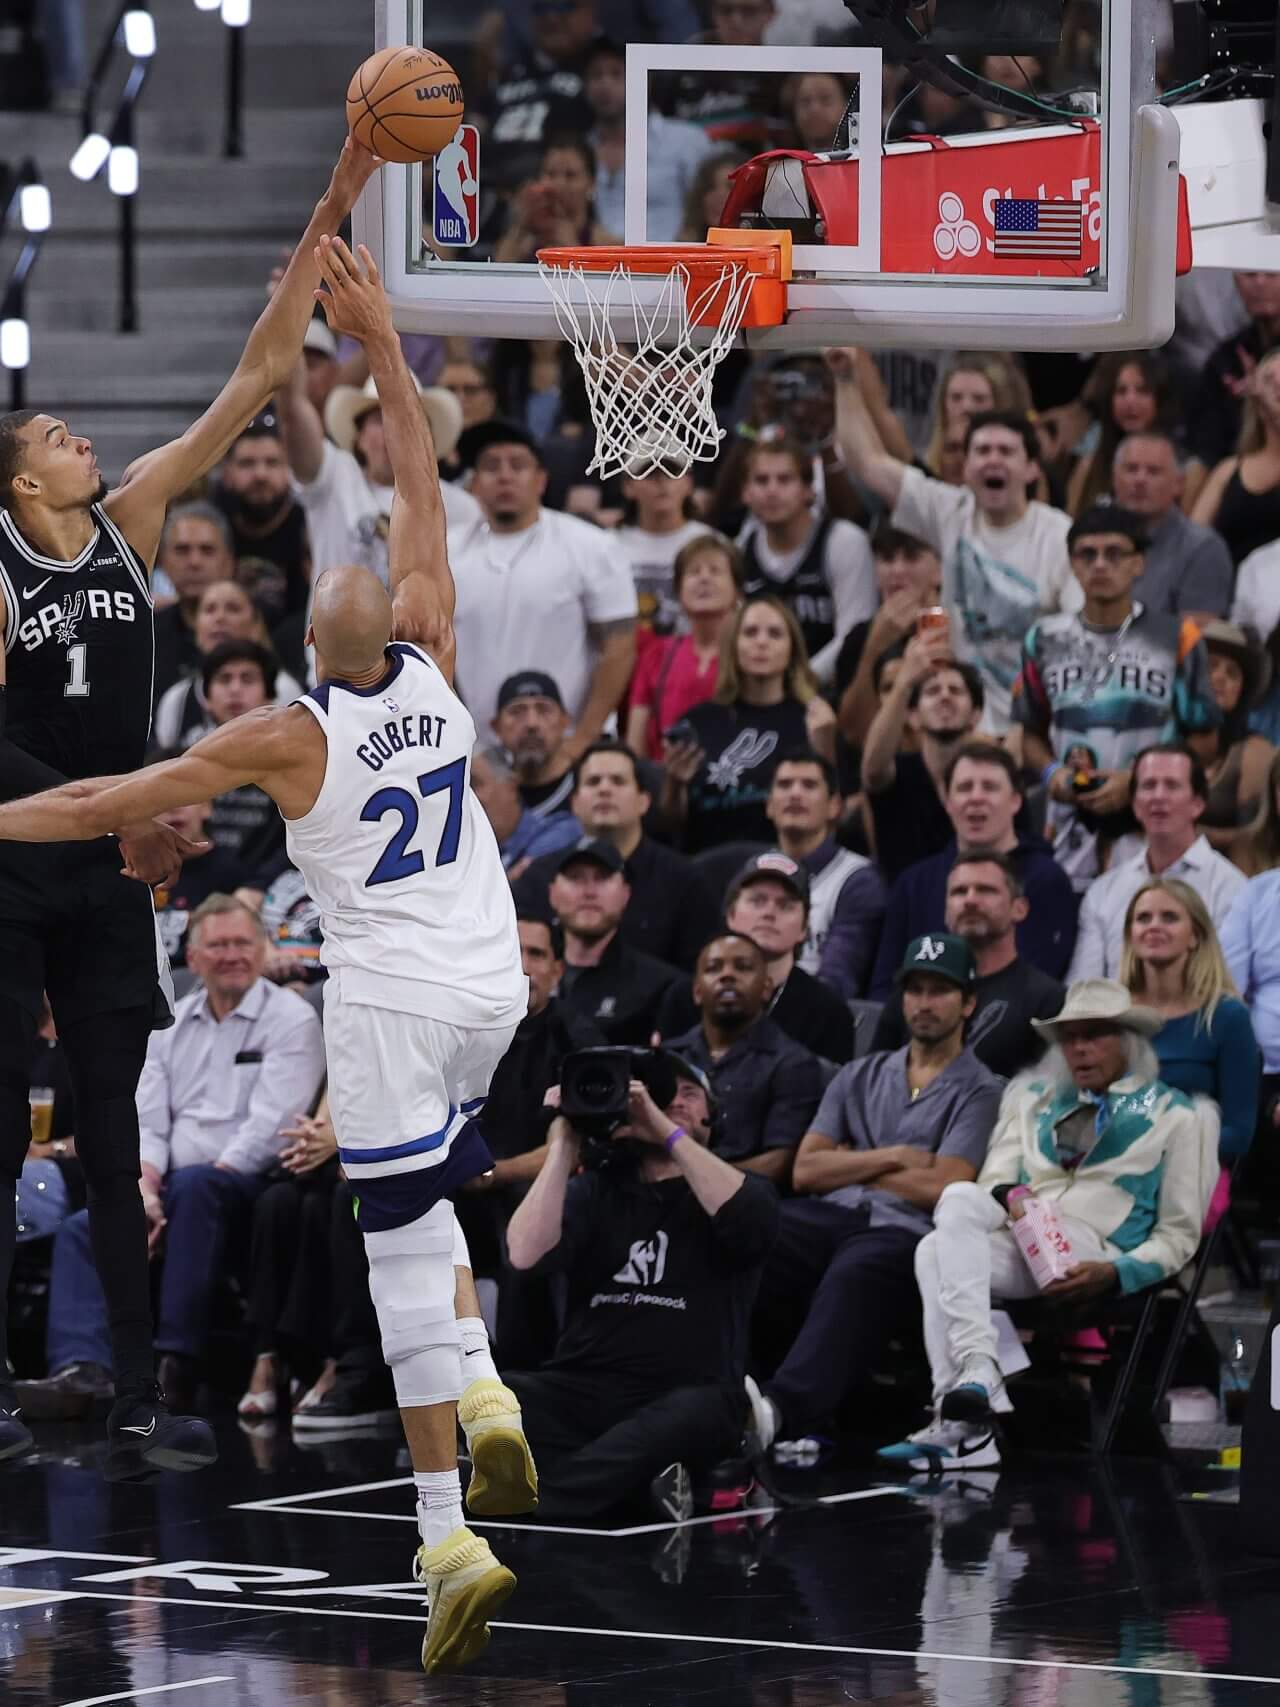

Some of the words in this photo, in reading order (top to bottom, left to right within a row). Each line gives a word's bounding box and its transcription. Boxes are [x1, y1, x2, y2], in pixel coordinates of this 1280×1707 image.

[439, 218, 461, 239] NBA
[18, 588, 136, 652] SPURS
[63, 642, 91, 697] 1
[355, 713, 447, 772] GOBERT
[359, 755, 468, 889] 27
